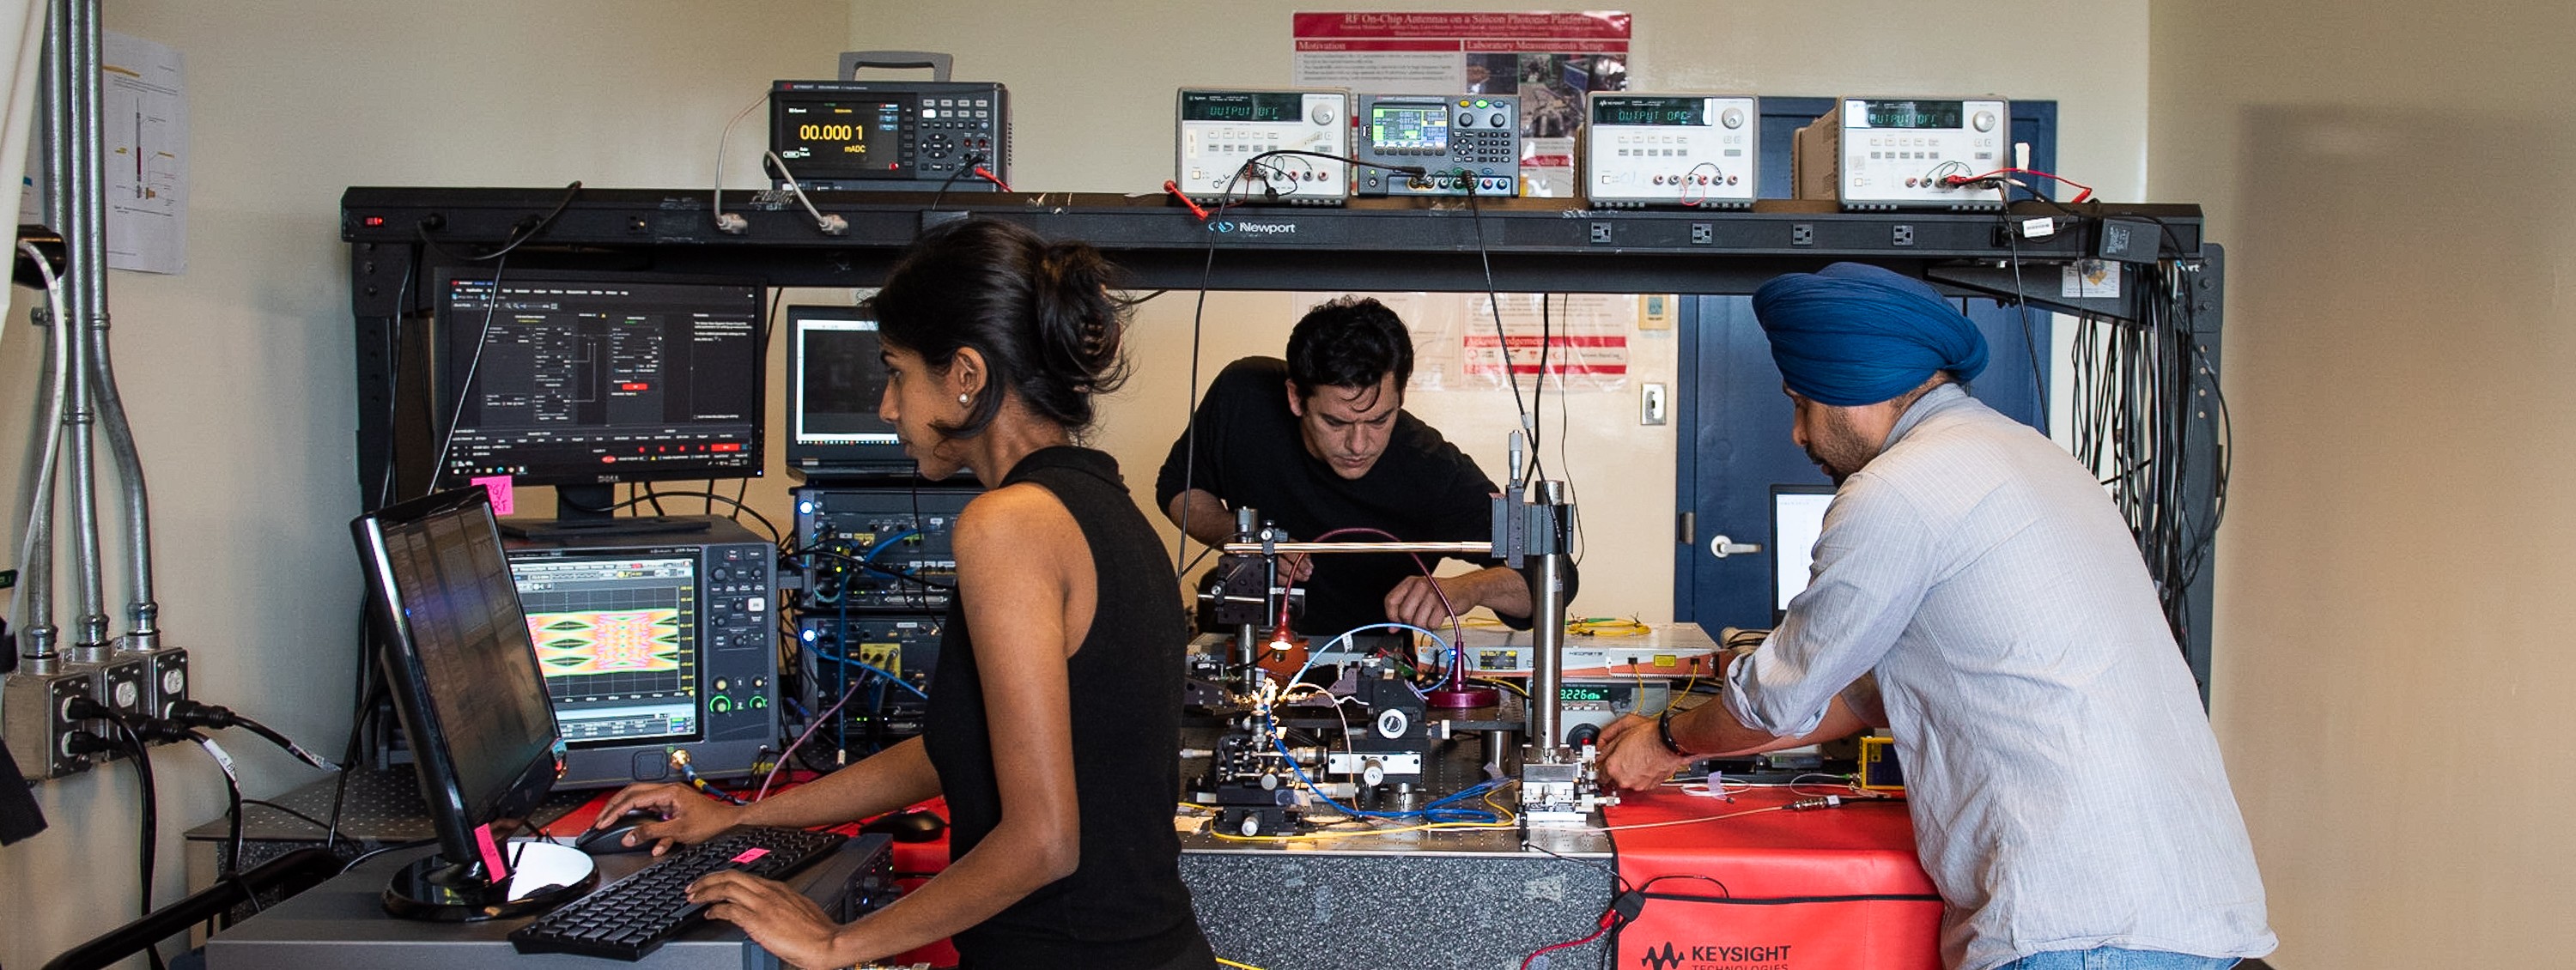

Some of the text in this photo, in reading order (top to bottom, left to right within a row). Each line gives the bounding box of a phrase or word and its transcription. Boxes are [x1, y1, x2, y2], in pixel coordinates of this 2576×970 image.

[1297, 41, 1346, 51] Motivation
[1466, 40, 1512, 52] Laboratory
[1209, 106, 1250, 117] OUTPUT
[1619, 111, 1659, 121] OUTPUT
[799, 125, 852, 141] 00.000
[1239, 221, 1296, 235] Newport
[1692, 945, 1791, 961] KEYSIGHT
